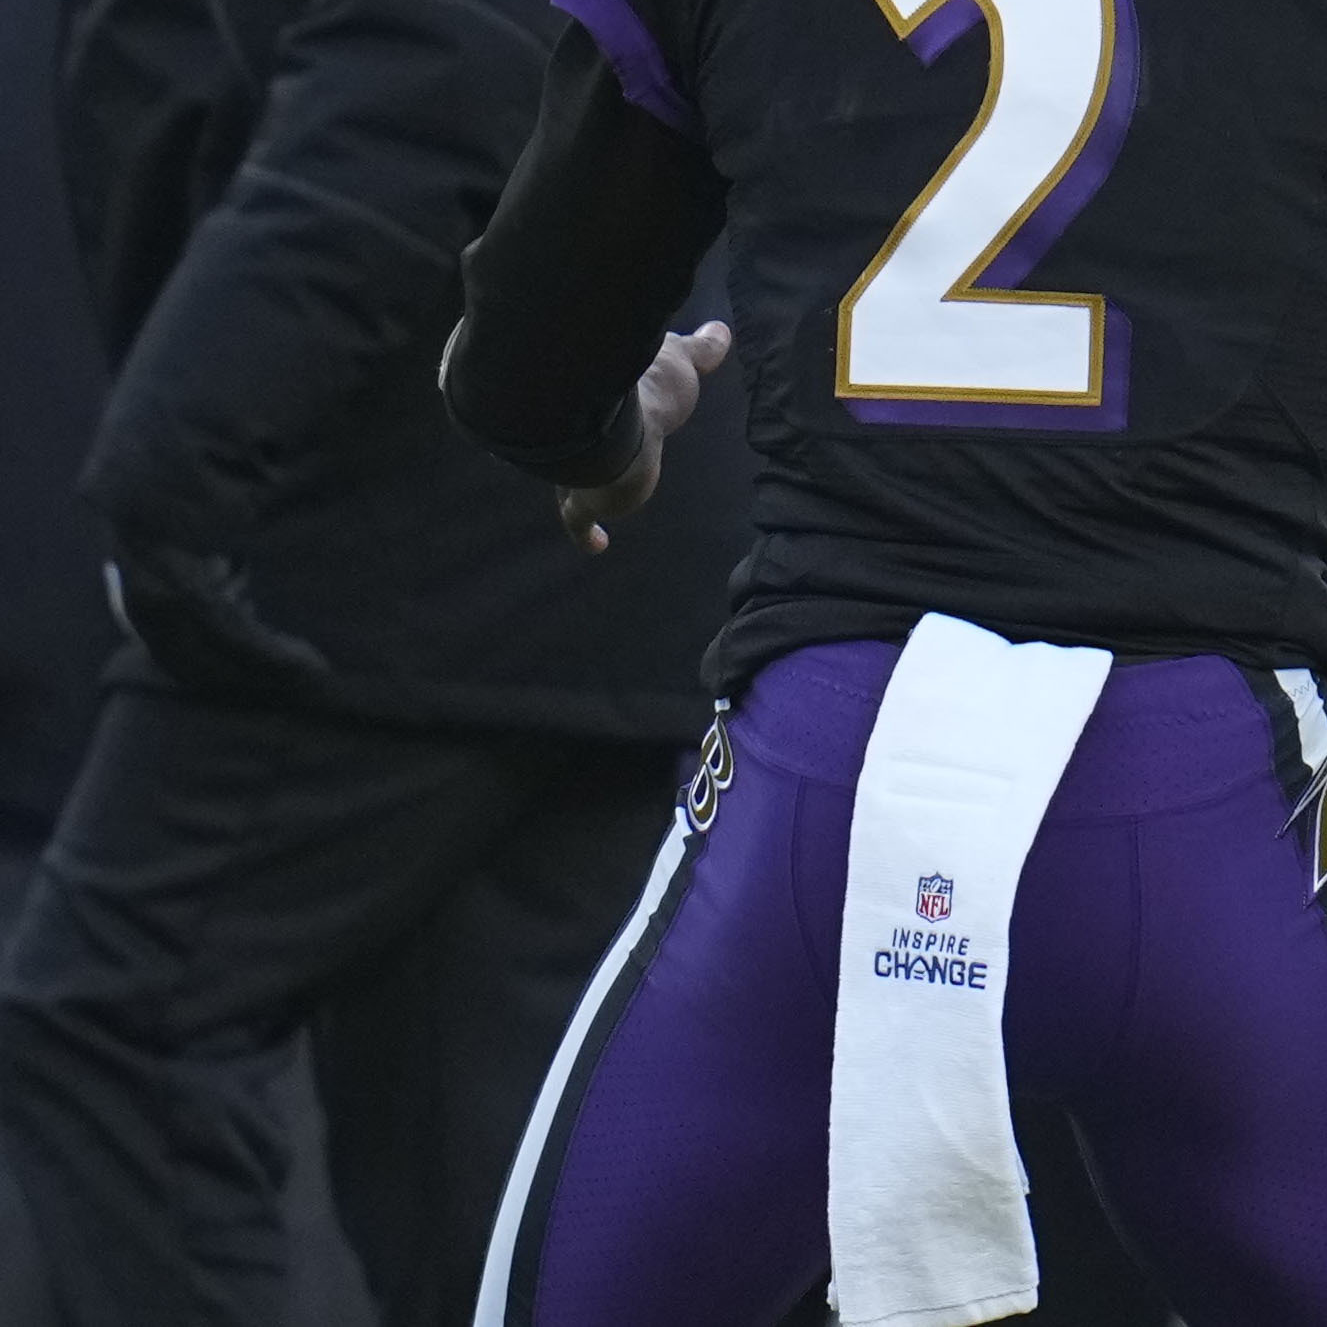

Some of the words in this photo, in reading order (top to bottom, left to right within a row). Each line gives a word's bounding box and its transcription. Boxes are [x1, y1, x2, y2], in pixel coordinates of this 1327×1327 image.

[918, 893, 949, 919] NFL
[892, 927, 970, 956] INSPIRE
[874, 950, 988, 990] CHANGE
